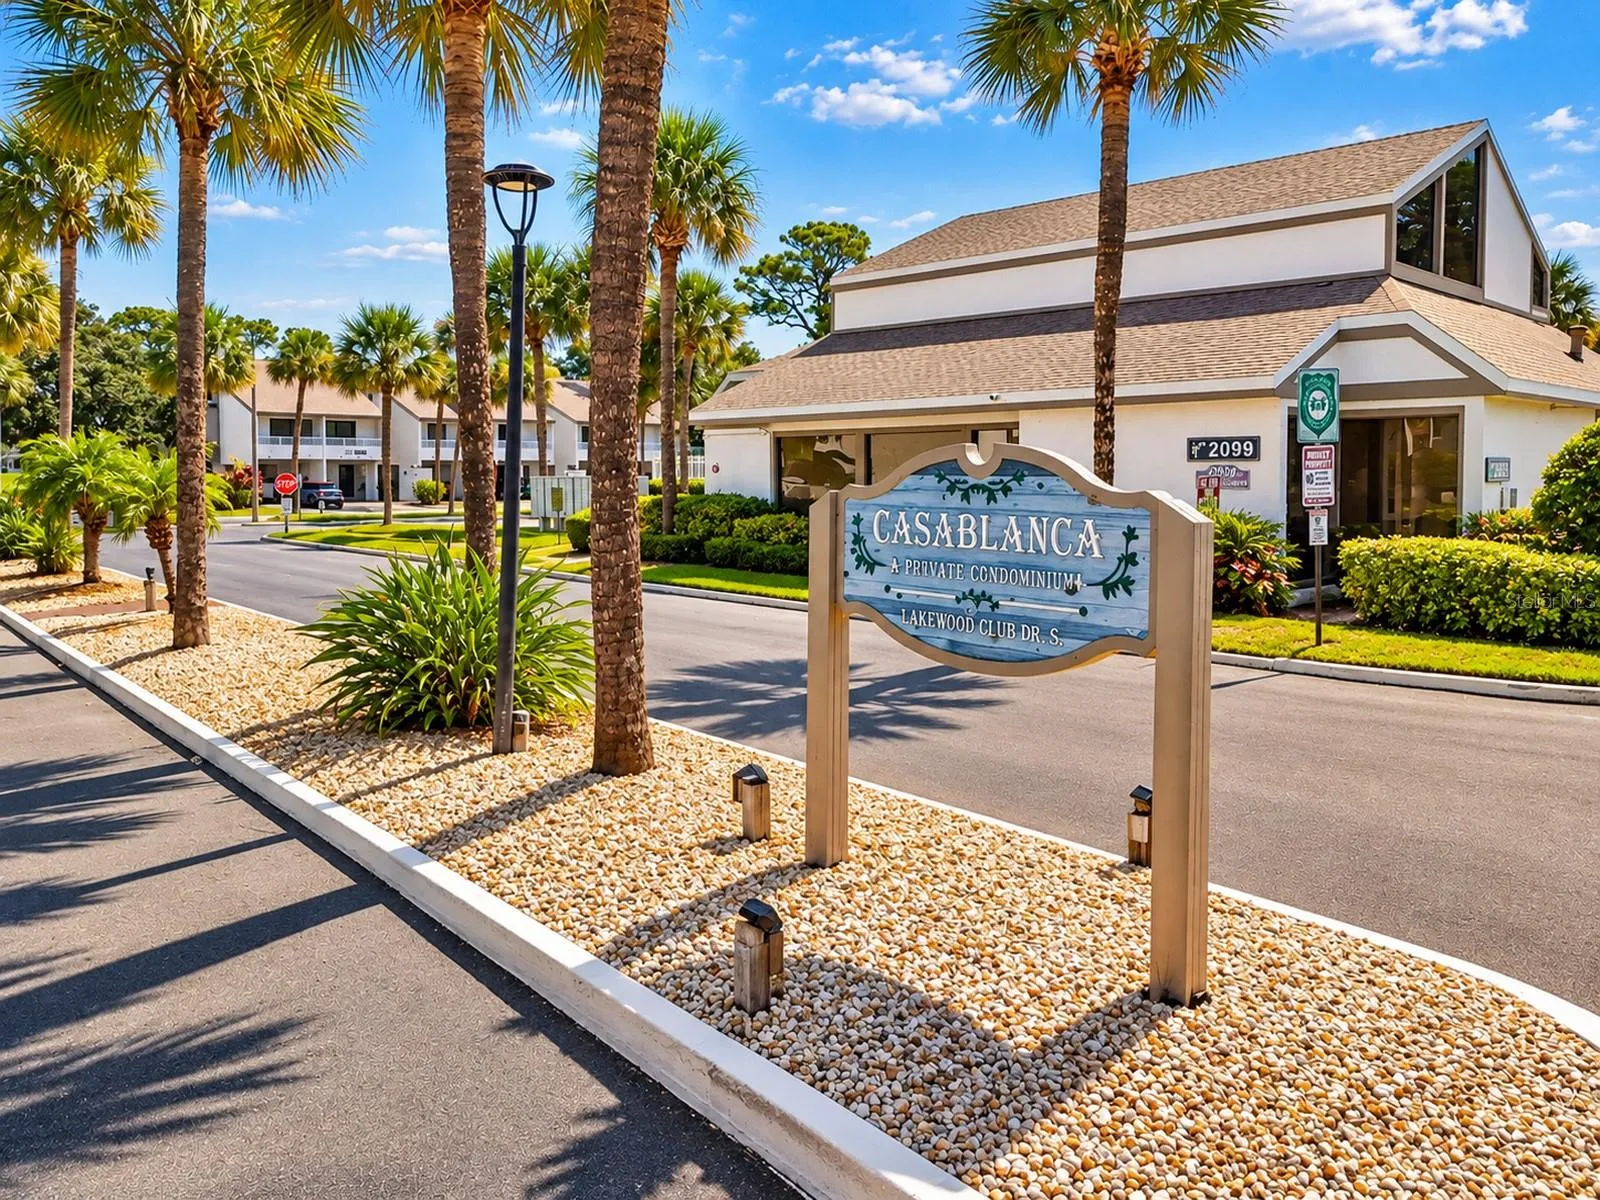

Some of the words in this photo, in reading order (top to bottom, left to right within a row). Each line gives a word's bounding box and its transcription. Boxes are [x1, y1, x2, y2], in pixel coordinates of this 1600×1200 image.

[1208, 440, 1254, 458] 2099
[277, 480, 296, 489] STOP
[872, 509, 1104, 559] CASABLANCA
[890, 557, 900, 574] A
[905, 559, 965, 580] PRIVATE
[970, 564, 1076, 592] CONDOMINIUM
[901, 608, 975, 633] LAKEWOOD
[979, 618, 1016, 639] CLUB
[1021, 624, 1046, 644] DR.
[1049, 627, 1064, 647] S.
